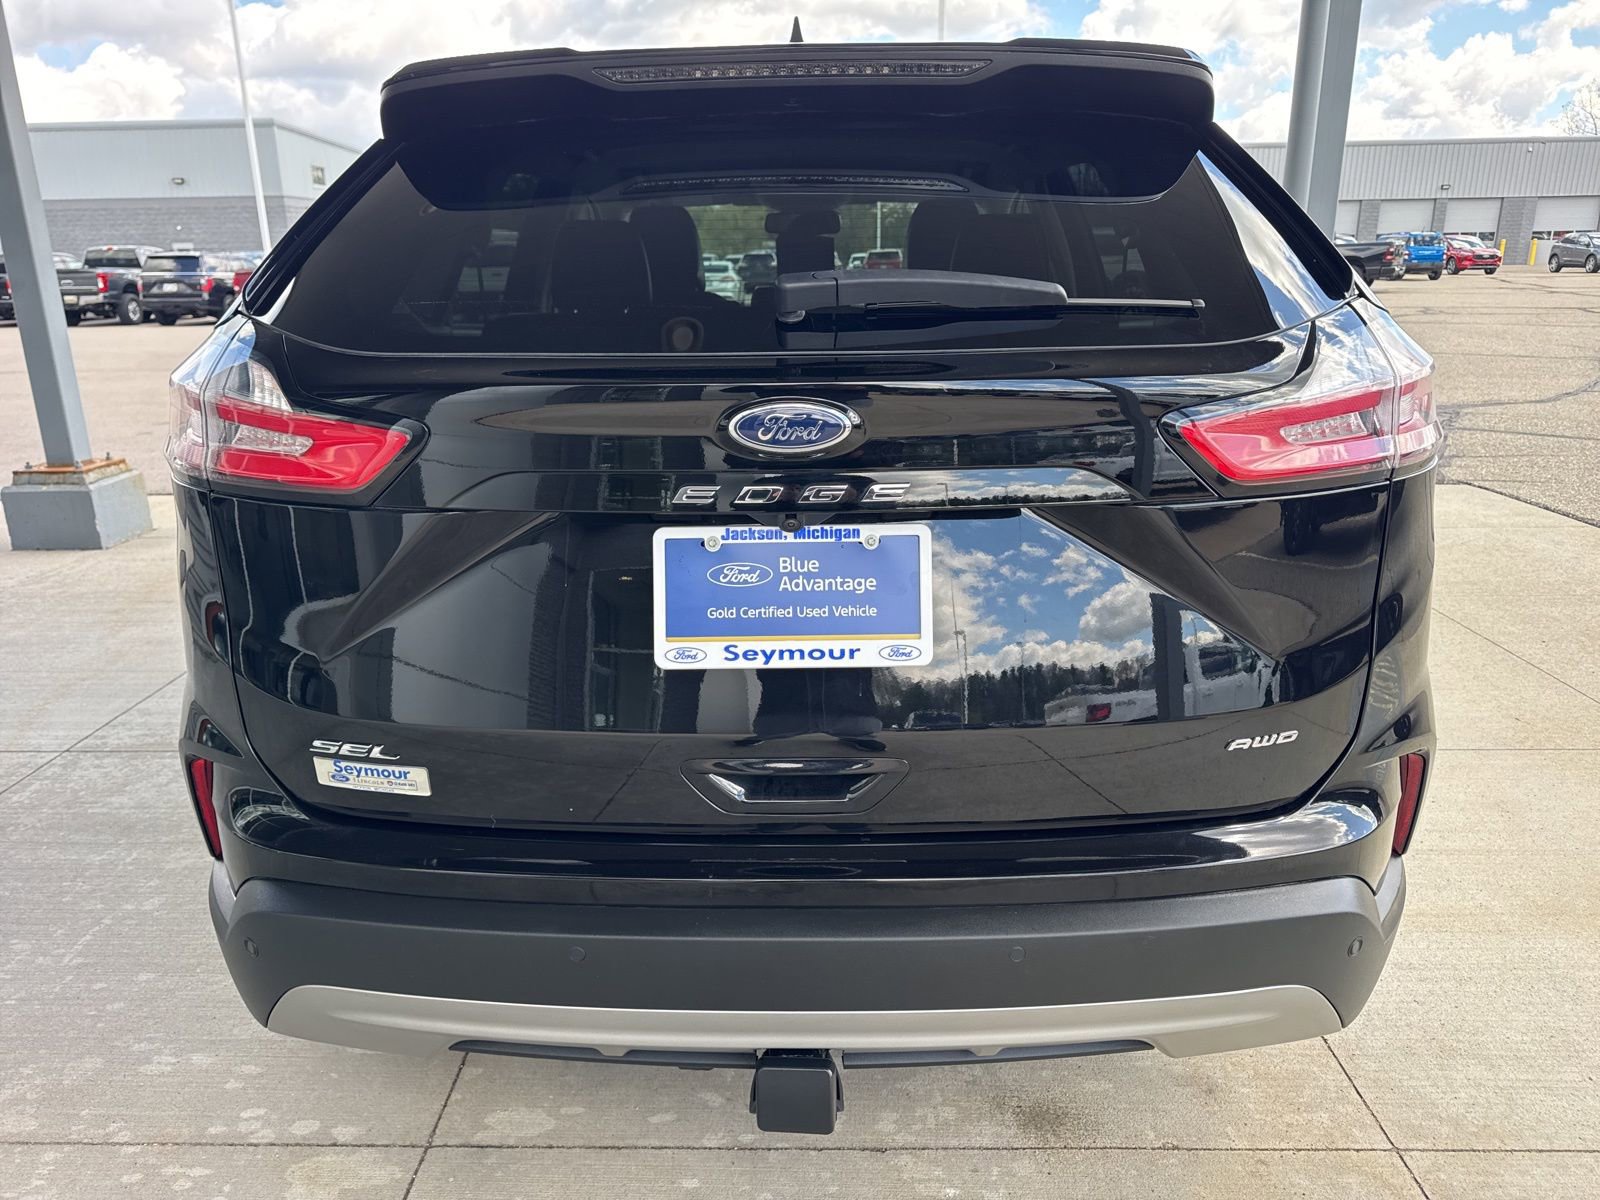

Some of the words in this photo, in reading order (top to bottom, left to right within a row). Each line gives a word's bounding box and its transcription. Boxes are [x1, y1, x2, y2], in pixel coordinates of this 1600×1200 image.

[757, 412, 823, 442] Ford
[671, 482, 910, 503] EDGE
[721, 528, 788, 541] Jackson,
[793, 527, 860, 541] Michigan
[719, 567, 760, 583] Ford
[779, 557, 819, 573] Blue
[778, 575, 877, 593] Advantage
[707, 607, 737, 619] Gold
[740, 605, 793, 618] Certified
[797, 605, 828, 617] Used
[832, 605, 877, 617] Vehicle
[673, 648, 698, 661] Ford
[723, 644, 861, 665] Seymour
[888, 645, 913, 658] Ford
[309, 739, 401, 760] SEL
[1226, 730, 1299, 751] AWD
[333, 759, 410, 780] Seymour
